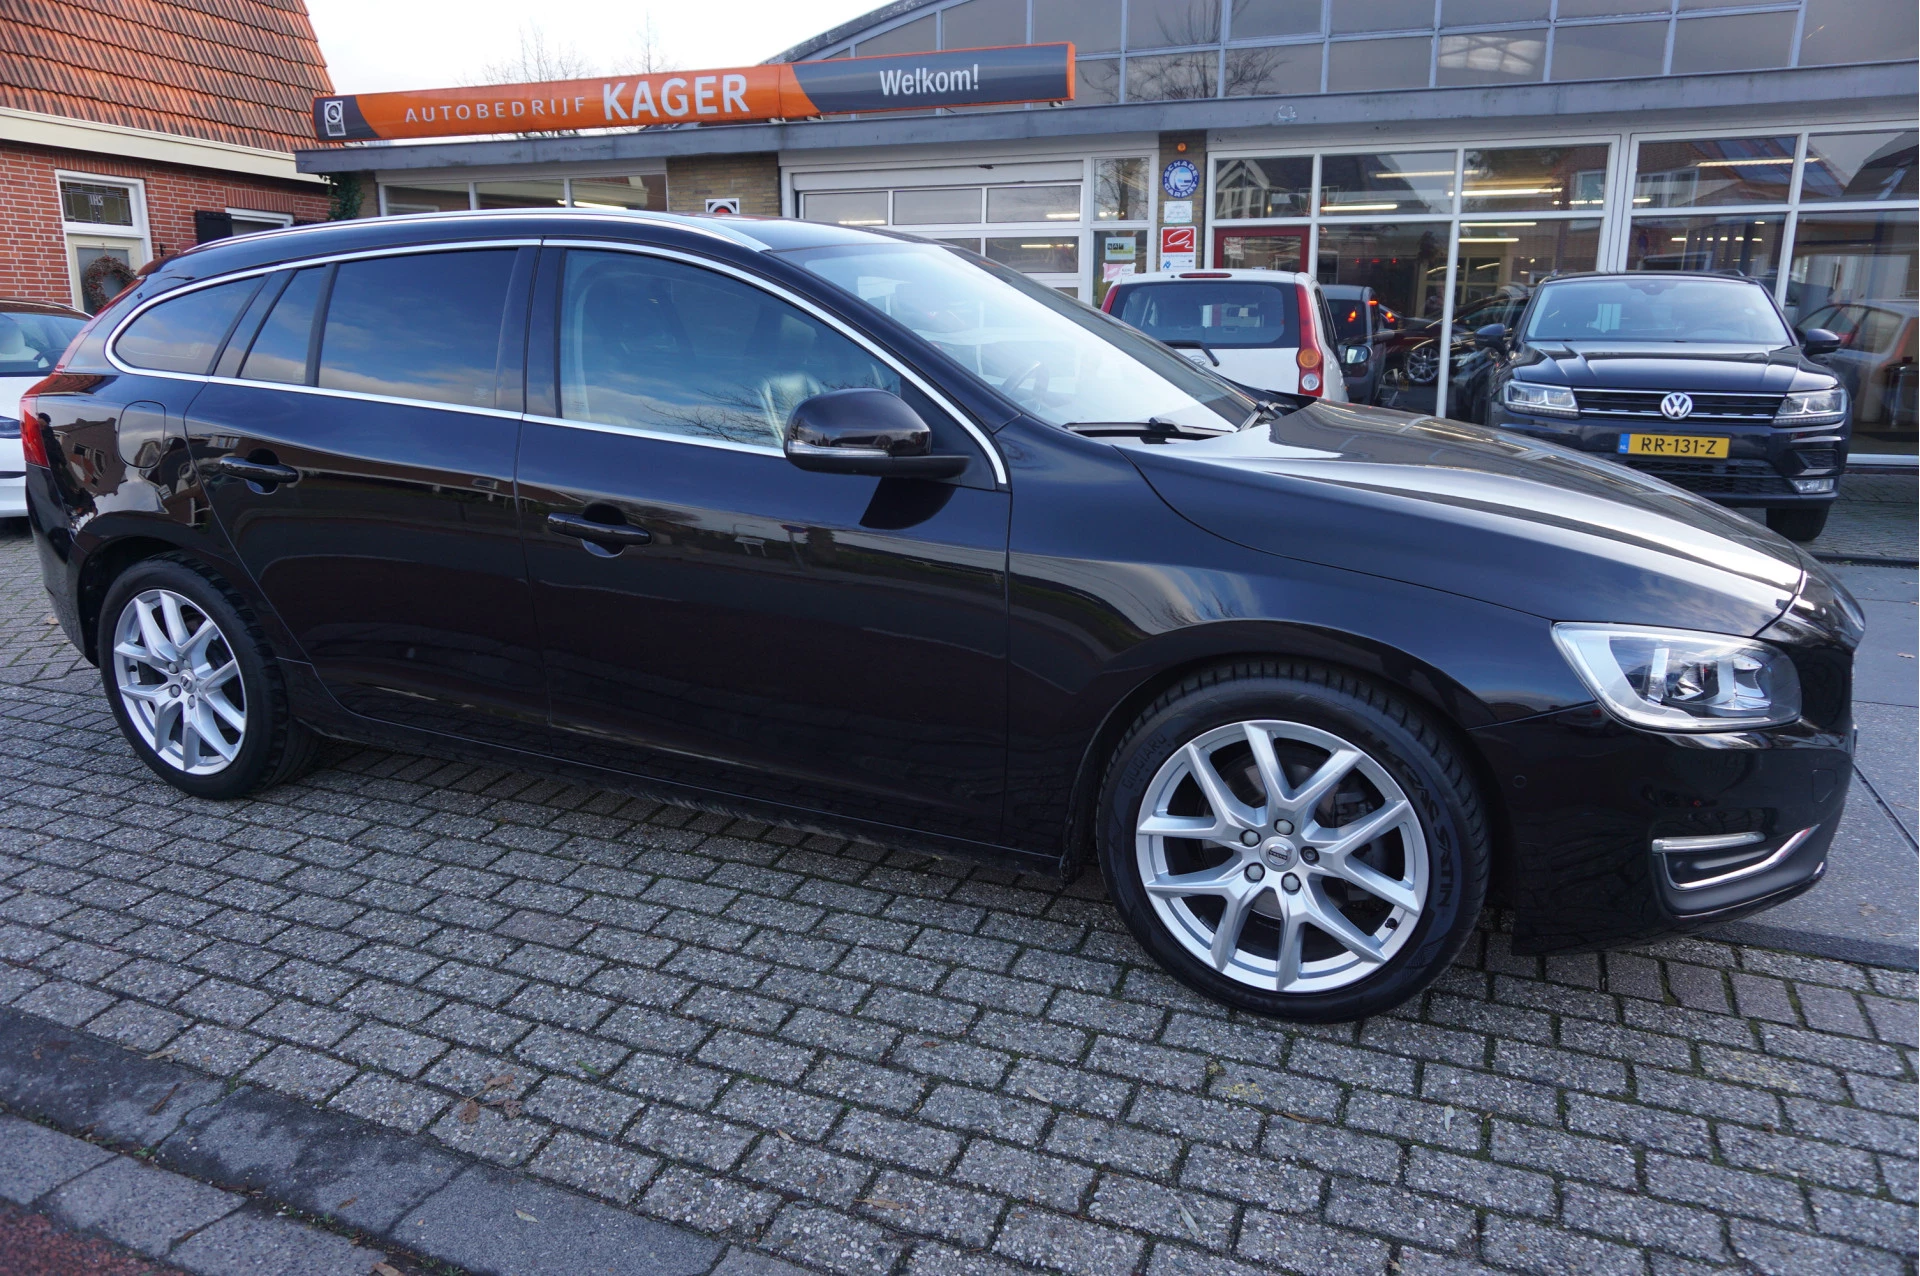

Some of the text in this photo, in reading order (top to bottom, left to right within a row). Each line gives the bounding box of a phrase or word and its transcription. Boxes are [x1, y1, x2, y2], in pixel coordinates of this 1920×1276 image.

[880, 64, 978, 95] Welkom!
[405, 74, 750, 123] AUTOBEDRIJF KAGER
[1164, 160, 1199, 177] SCHADE
[1164, 181, 1198, 198] GARANT
[1641, 437, 1718, 455] RR-131-Z
